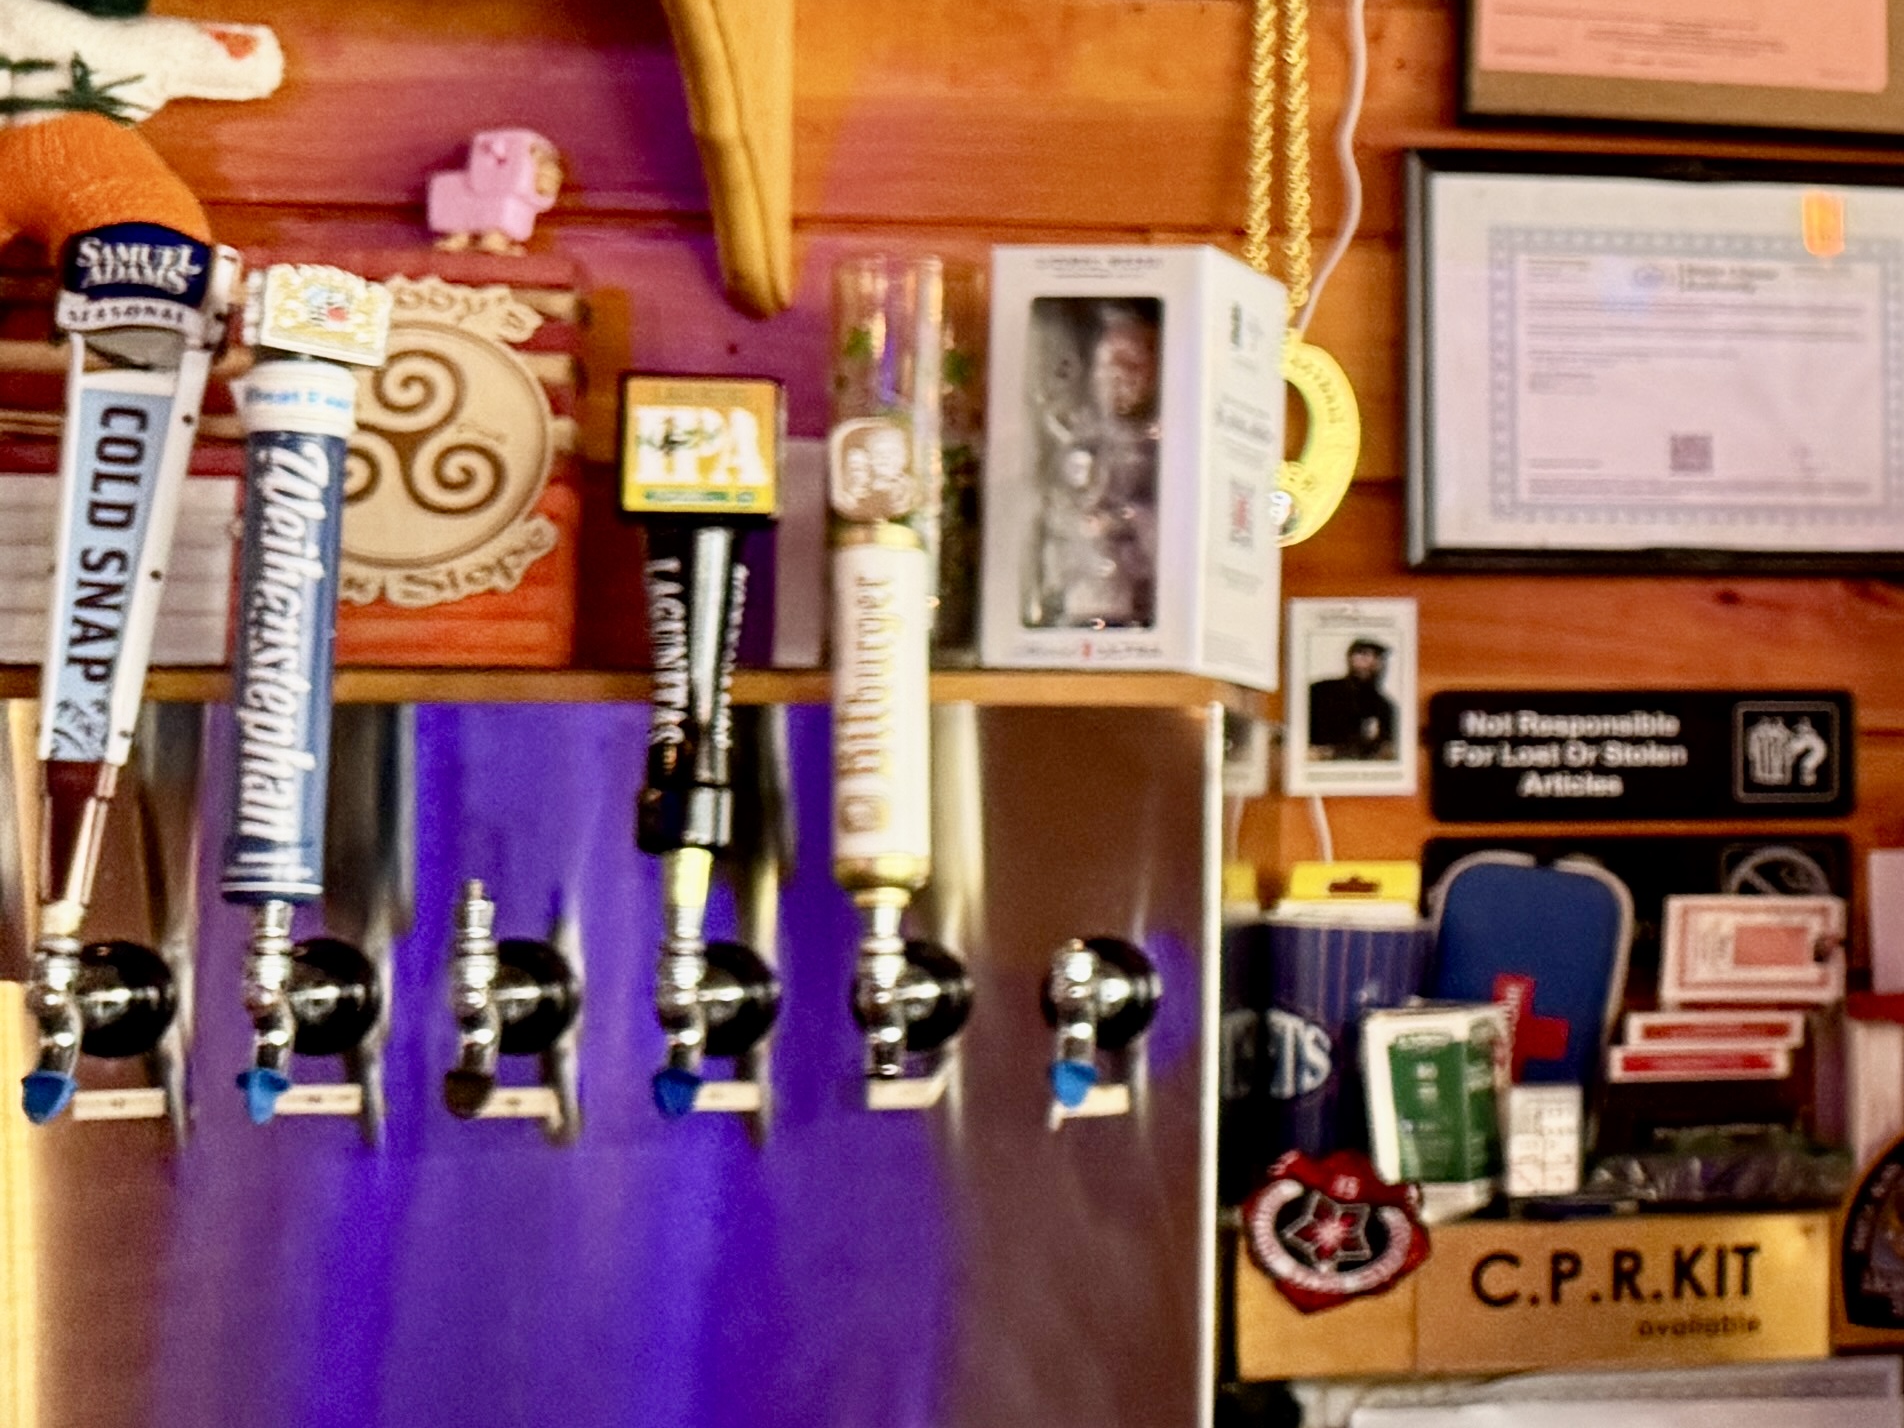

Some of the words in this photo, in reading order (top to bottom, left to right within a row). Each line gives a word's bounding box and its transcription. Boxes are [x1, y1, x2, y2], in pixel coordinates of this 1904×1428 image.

[75, 236, 202, 275] SAMUEL
[80, 260, 189, 295] ADAMS
[66, 303, 186, 324] SEASONAL
[632, 403, 770, 484] IPA
[87, 405, 149, 532] COLD
[65, 546, 129, 684] SNAP
[1459, 709, 1512, 738] Not
[1514, 709, 1682, 740] Responsible
[1442, 739, 1497, 768] For
[1496, 739, 1561, 768] Lost
[1561, 739, 1598, 768] Or
[1600, 739, 1689, 768] Stolen
[1516, 770, 1625, 798] Articles
